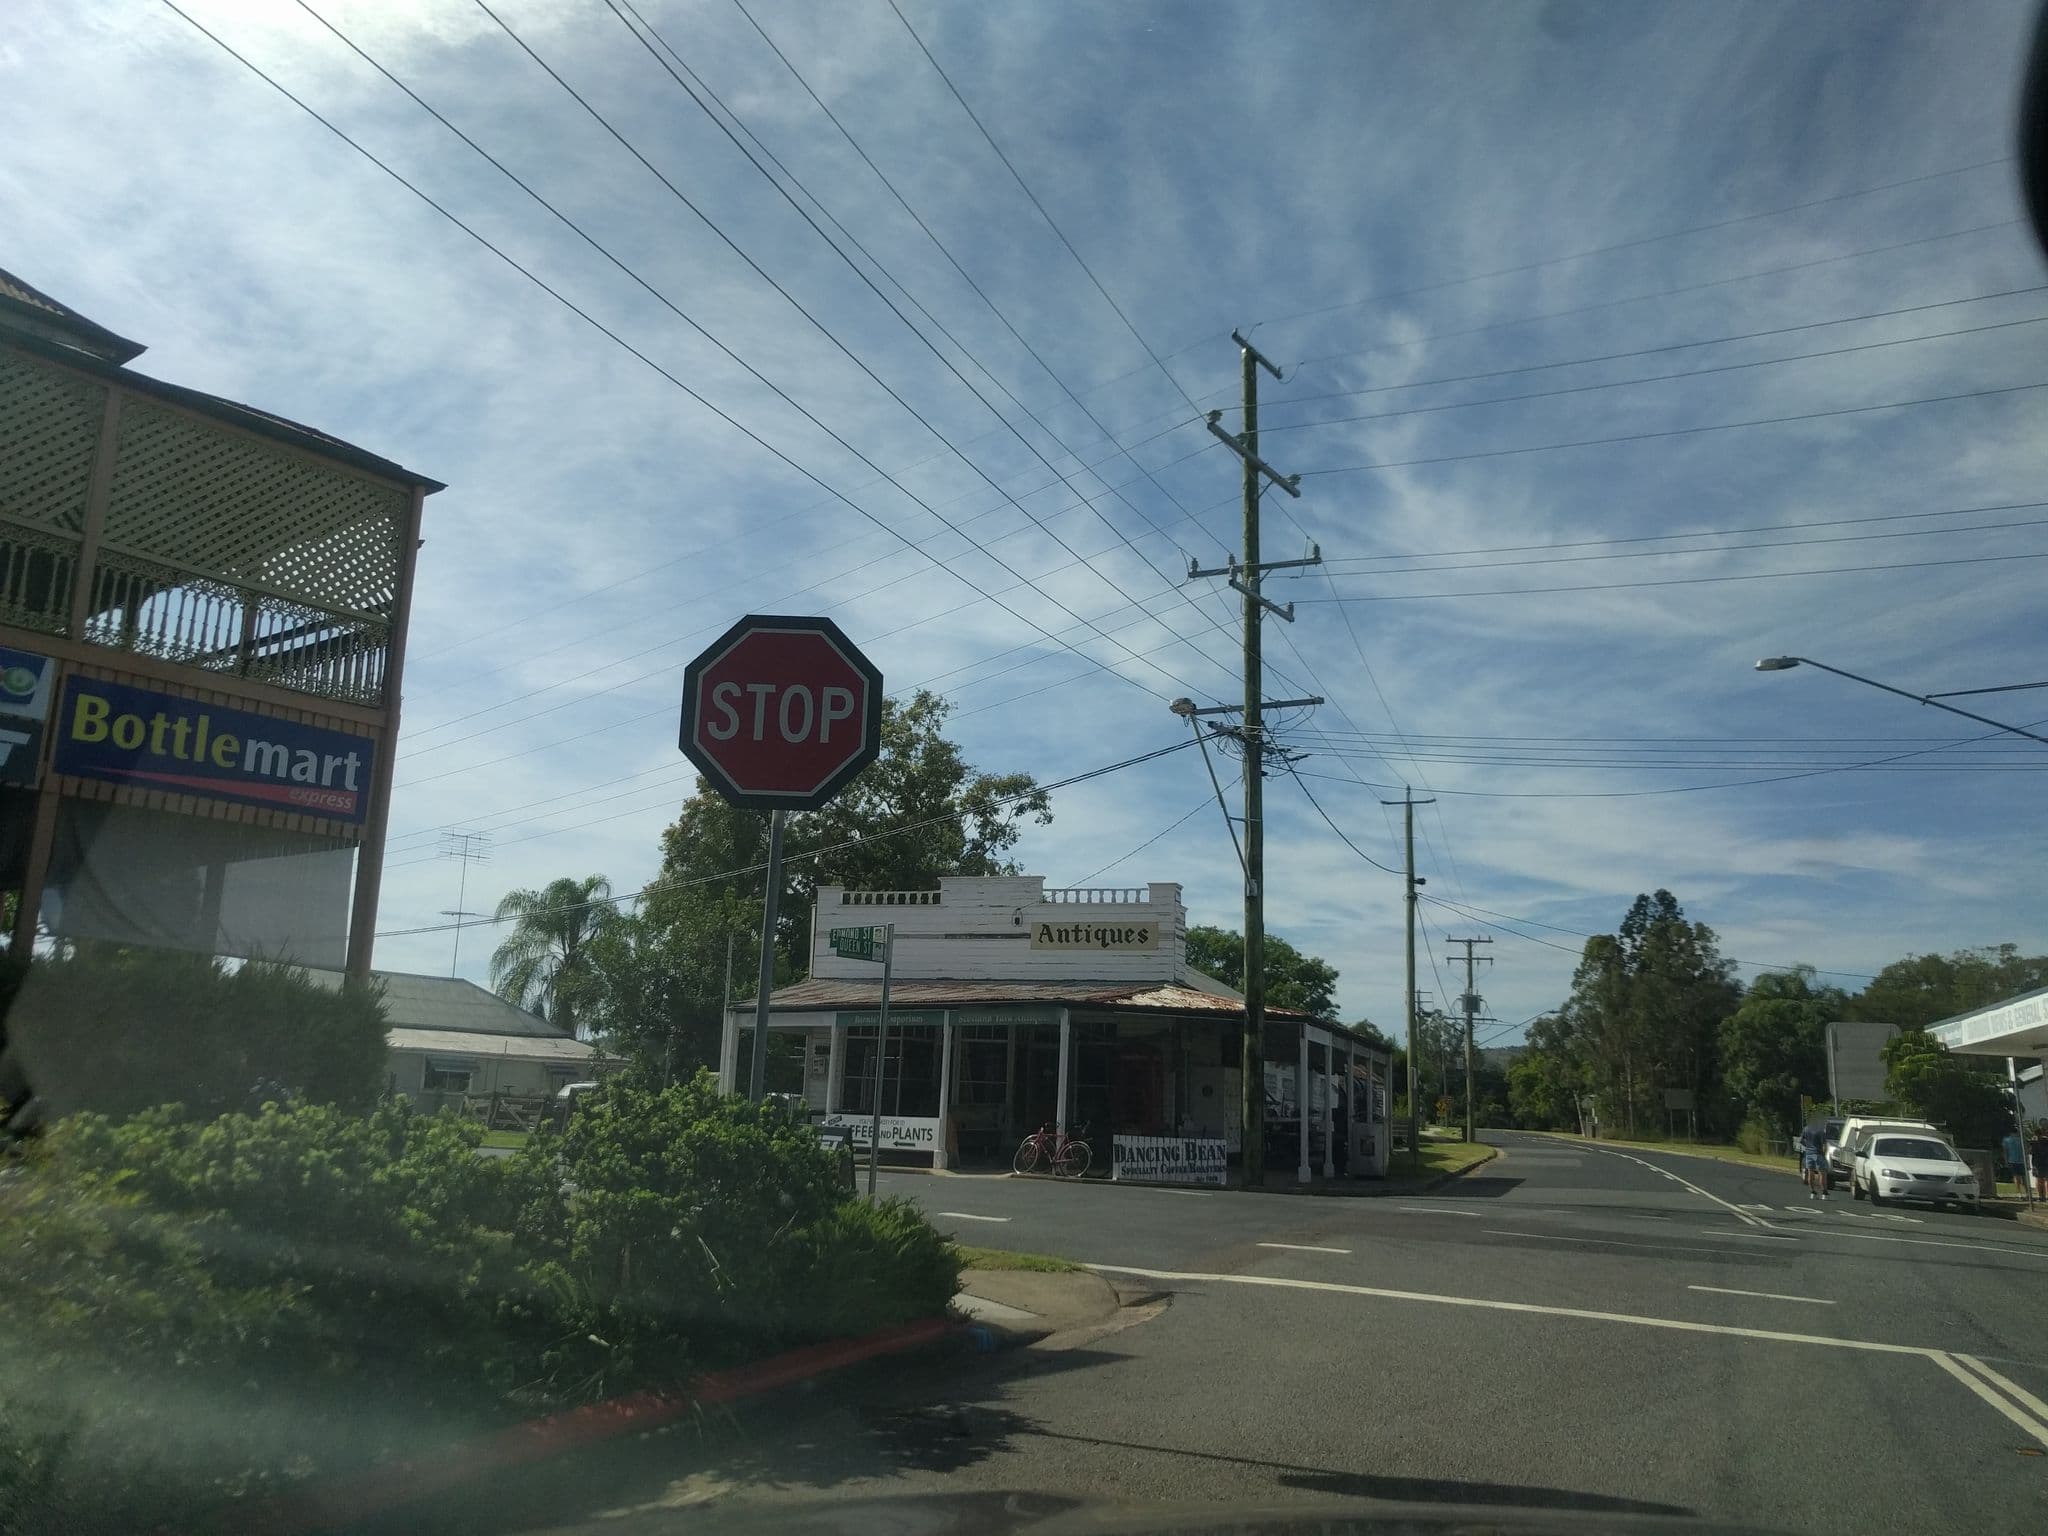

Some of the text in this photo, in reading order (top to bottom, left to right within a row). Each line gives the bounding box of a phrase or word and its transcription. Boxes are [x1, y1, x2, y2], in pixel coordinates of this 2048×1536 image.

[708, 681, 855, 744] STOP
[71, 693, 362, 792] Bottlemart
[288, 790, 353, 809] express
[832, 927, 871, 941] EDMOND ST
[1038, 924, 1150, 949] Antiques
[839, 938, 871, 954] QUEEN ST
[892, 1126, 934, 1142] PLANTS
[1113, 1141, 1226, 1162] DANCING BEAN
